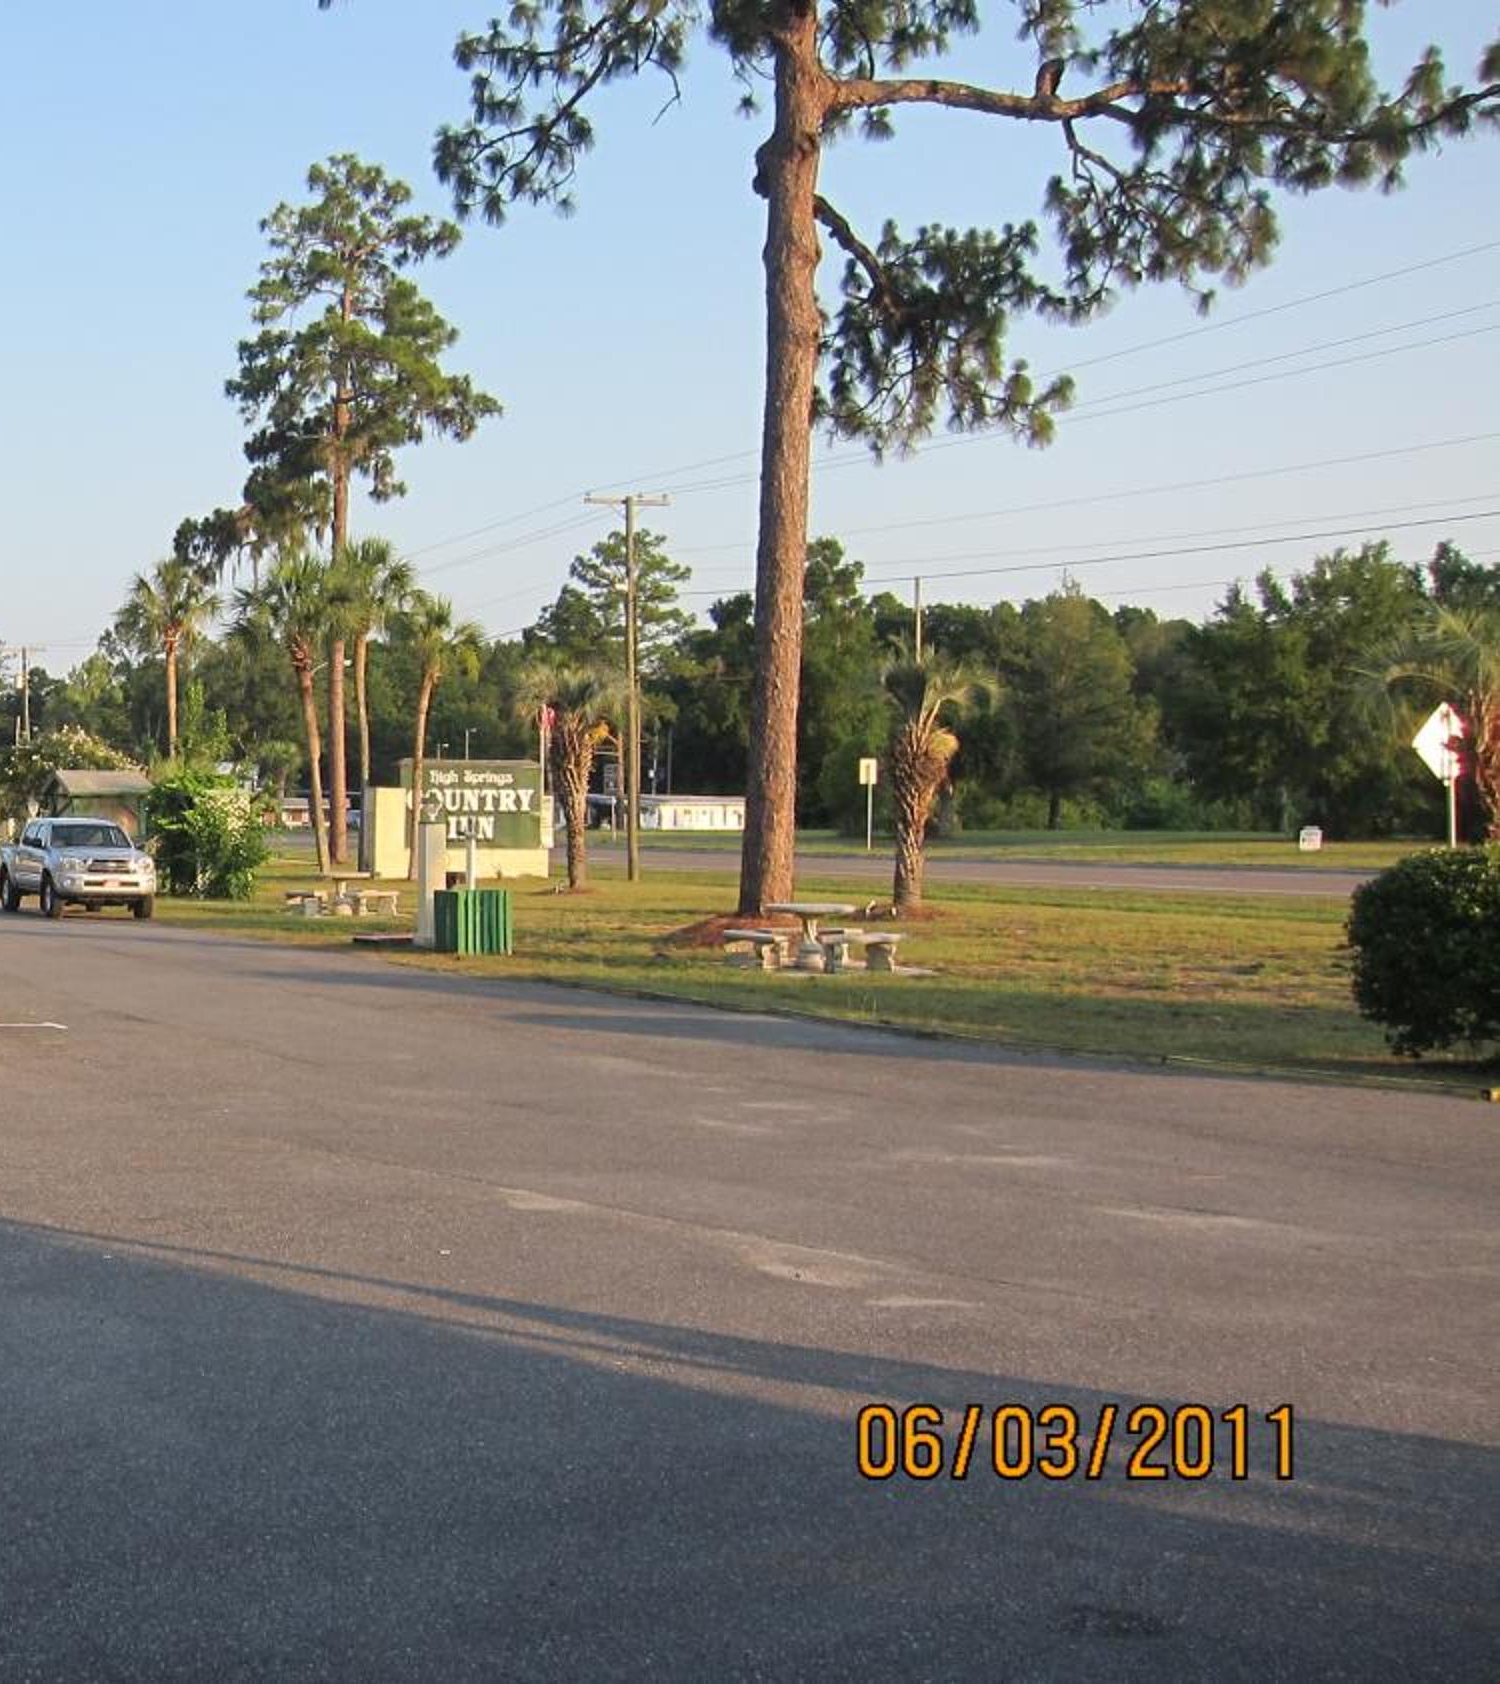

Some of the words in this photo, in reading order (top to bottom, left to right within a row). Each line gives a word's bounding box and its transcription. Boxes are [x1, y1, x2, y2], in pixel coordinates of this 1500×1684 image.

[429, 769, 459, 785] High
[463, 769, 515, 786] Springs
[447, 815, 495, 840] INN
